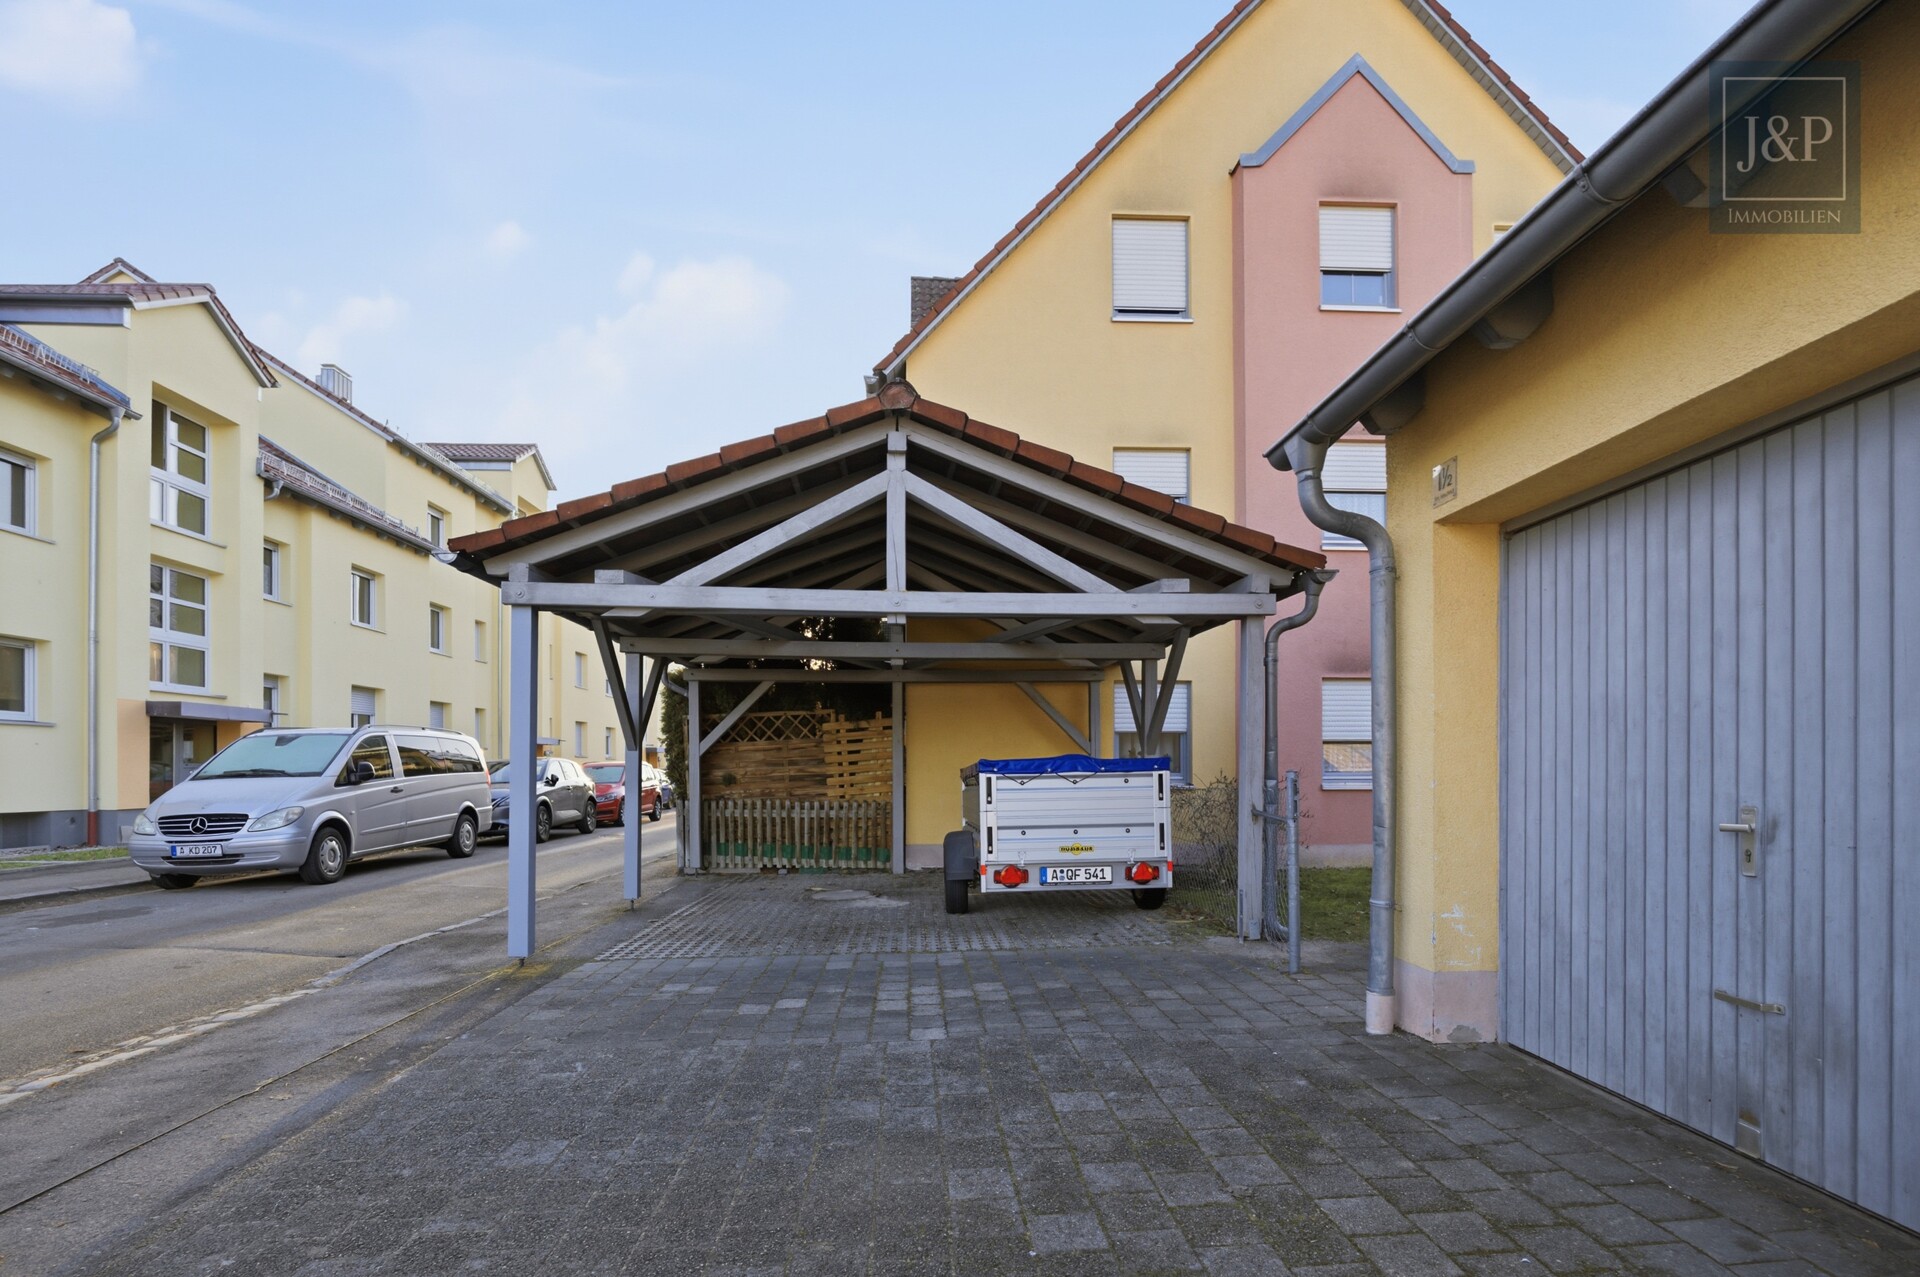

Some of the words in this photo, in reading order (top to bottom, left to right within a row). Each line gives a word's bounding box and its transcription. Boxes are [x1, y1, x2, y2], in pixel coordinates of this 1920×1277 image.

[189, 846, 200, 854] KD
[202, 845, 217, 854] 207
[1051, 869, 1059, 881] A
[1066, 868, 1081, 881] QF
[1084, 868, 1107, 880] 541
